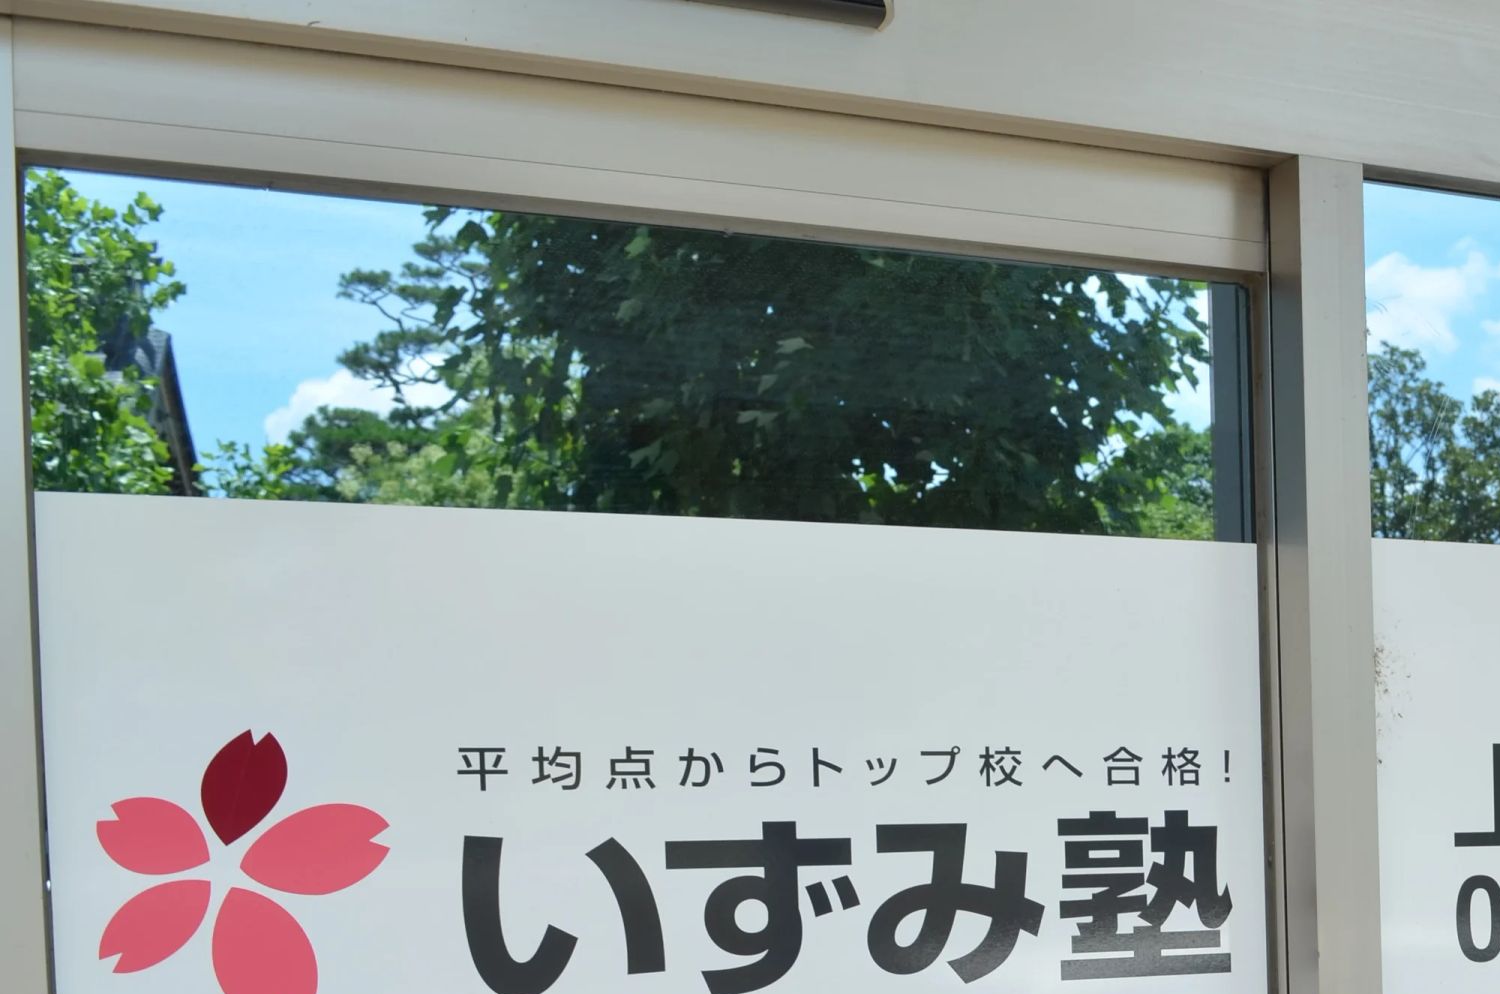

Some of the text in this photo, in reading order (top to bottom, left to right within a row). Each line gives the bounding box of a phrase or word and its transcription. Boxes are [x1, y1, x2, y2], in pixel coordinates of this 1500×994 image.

[456, 745, 1233, 792] 平均点からトップ校へ合格!
